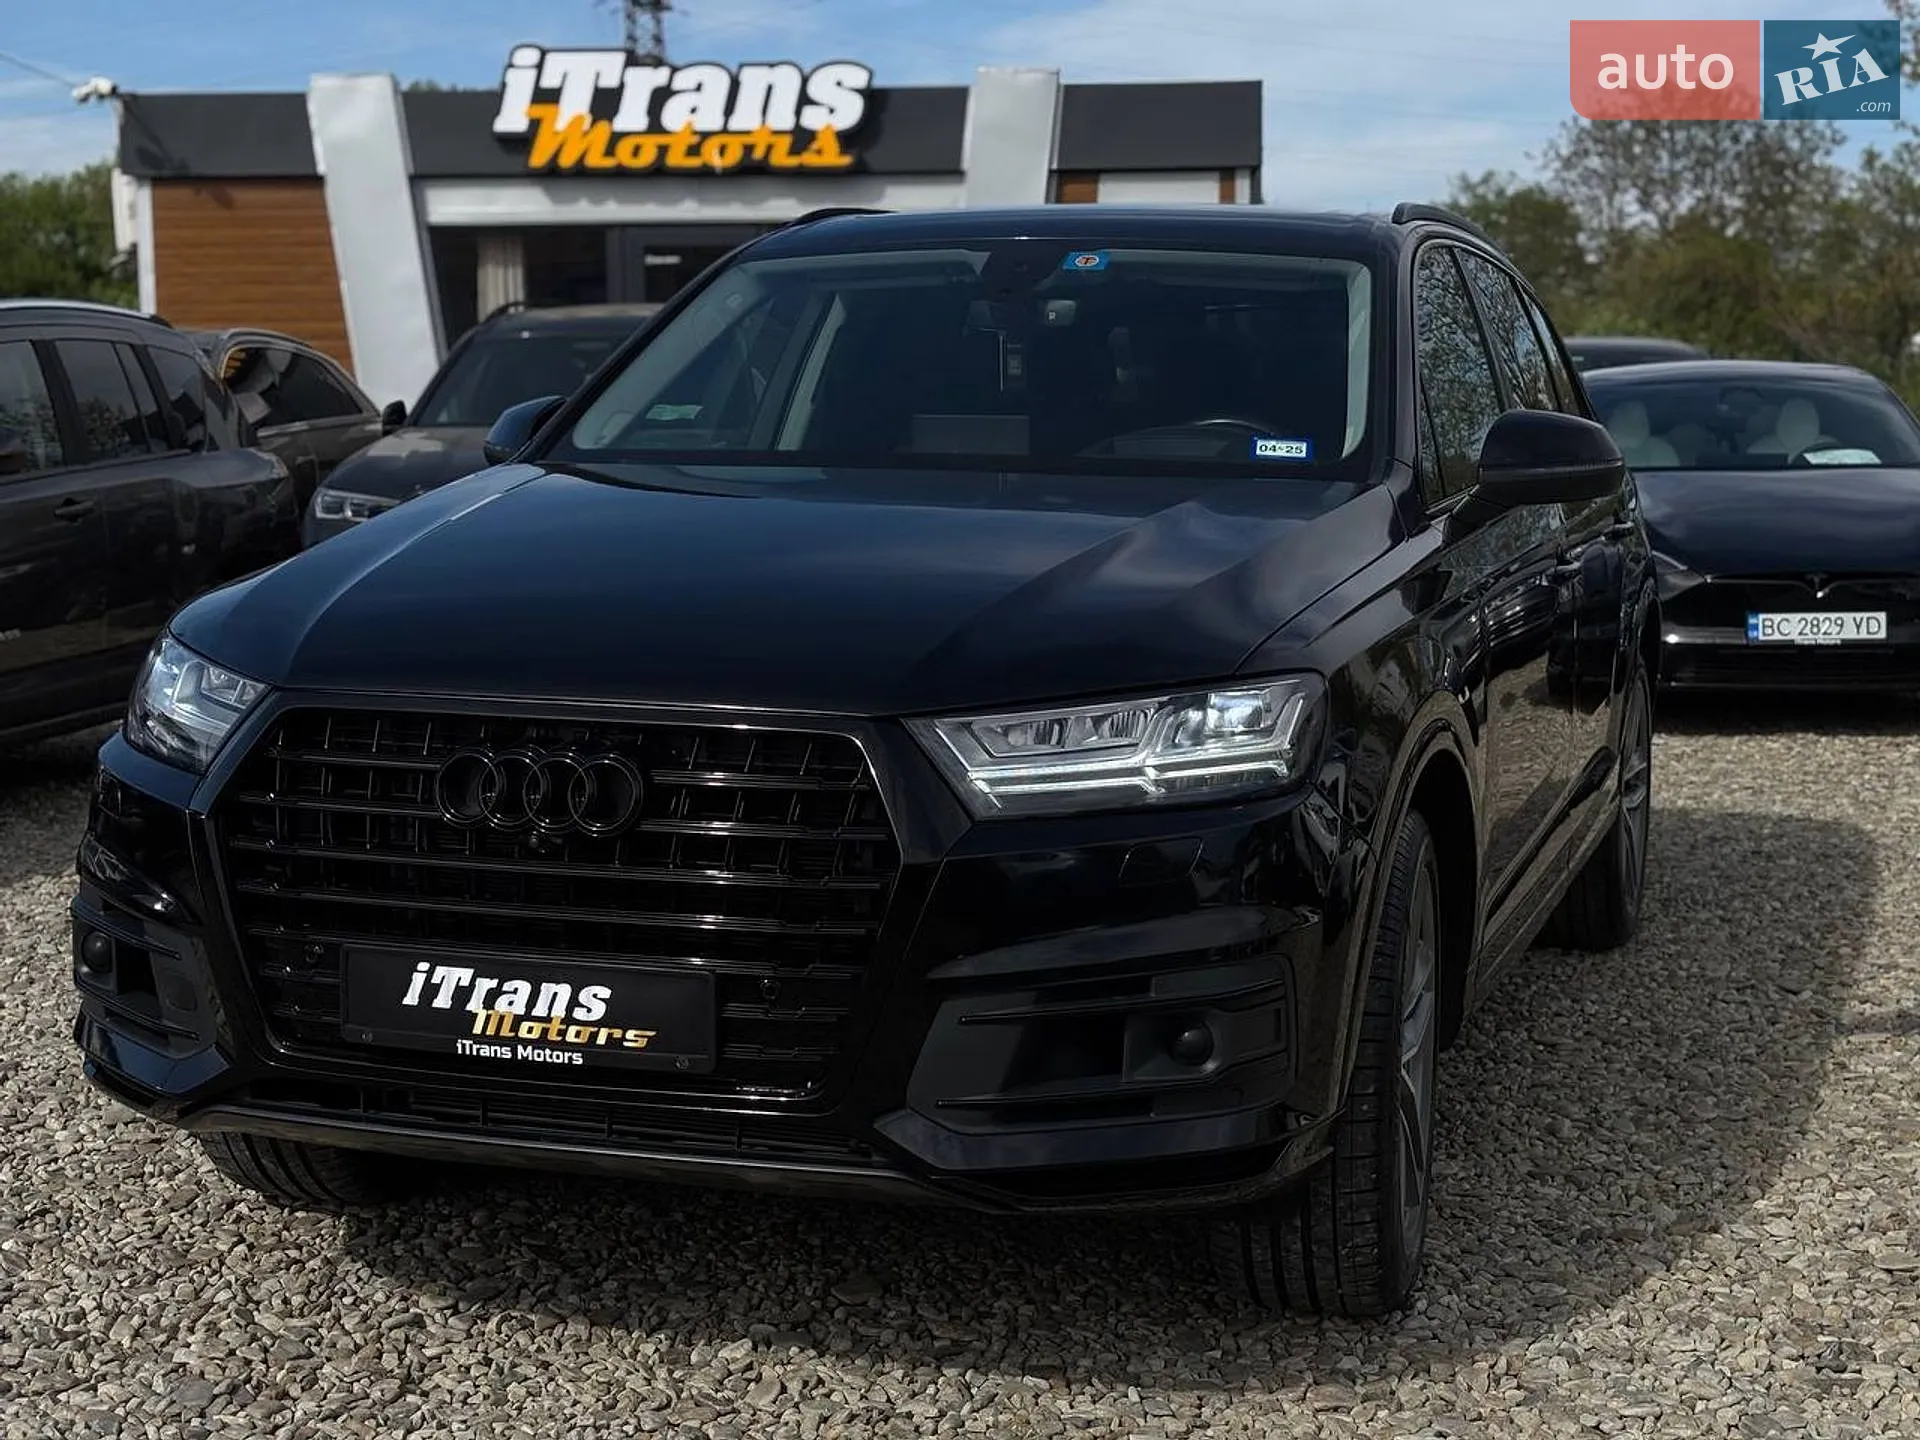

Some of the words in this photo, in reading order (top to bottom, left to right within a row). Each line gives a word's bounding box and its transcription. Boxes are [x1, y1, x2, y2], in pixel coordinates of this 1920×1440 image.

[493, 45, 870, 132] iTrans
[526, 104, 854, 169] Motors
[1762, 617, 1792, 637] BC
[1798, 616, 1844, 636] 2829
[1852, 616, 1882, 636] YD
[402, 961, 613, 1021] iTrans
[456, 1039, 512, 1059] iTrans
[517, 1045, 583, 1065] Motors
[472, 1008, 657, 1049] Motors
